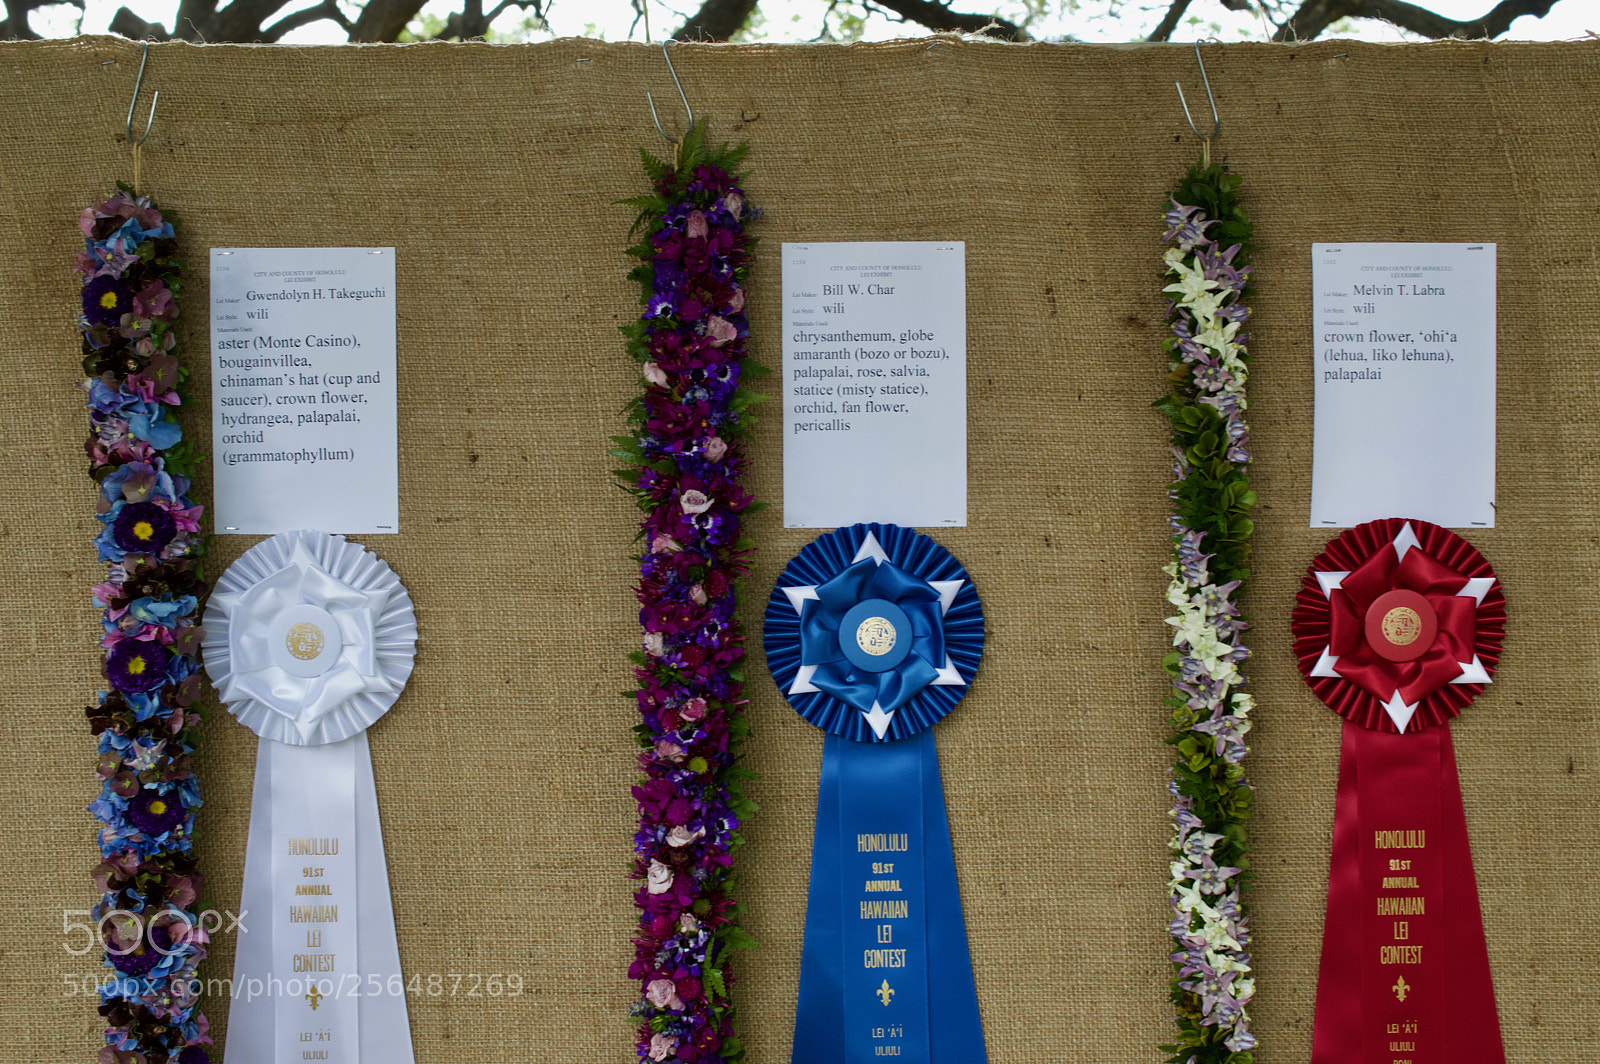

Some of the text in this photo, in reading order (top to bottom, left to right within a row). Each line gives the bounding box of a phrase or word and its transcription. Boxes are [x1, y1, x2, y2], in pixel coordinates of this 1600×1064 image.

[246, 287, 386, 302] Gwendolyn H. Takeguchi
[823, 284, 895, 296] Bill W. Char
[1353, 284, 1445, 296] Melvin T. Labra
[247, 309, 268, 319] wili
[822, 303, 844, 314] wili
[1353, 303, 1375, 313] wili
[218, 334, 360, 350] aster (Monte Casino),
[793, 330, 934, 344] chrysanthemum, globe
[1324, 333, 1364, 343] crown
[1369, 330, 1414, 343] flower,
[794, 348, 949, 361] amaranth (bozo or bozu),
[1324, 349, 1454, 363] (lehua, liko lehuna),
[219, 355, 312, 371] bougainvillea,
[299, 373, 319, 385] hat
[323, 373, 352, 387] (cup
[357, 371, 380, 383] and
[794, 365, 930, 381] palapalai, rose, salvia,
[1324, 368, 1381, 383] palapalai
[794, 383, 928, 397] statice (misty statice),
[221, 392, 368, 407] saucer), crown flower,
[794, 401, 909, 414] orchid, fan flower,
[221, 410, 360, 428] hydrangea, palapalai,
[794, 419, 850, 434] pericallis
[222, 431, 264, 444] orchid
[223, 448, 354, 465] (grammatophyllum)
[857, 834, 908, 852] HONOLULU
[1375, 830, 1425, 848] HONOLULU
[288, 837, 338, 856] HONOLULU
[872, 863, 894, 874] 91ST
[1389, 859, 1411, 870] 91ST
[302, 867, 324, 877] 91ST
[865, 880, 902, 892] ANNUAL
[1382, 877, 1419, 889] ANNUAL
[295, 885, 332, 896] ANNUAL
[860, 900, 908, 919] HAWAIIAN
[1377, 897, 1425, 915] HAWAIIAN
[290, 905, 338, 923] HAWAIIAN
[877, 925, 892, 943] LEI
[1394, 922, 1408, 939] LEI
[307, 930, 321, 947] LEI
[864, 949, 906, 968] CONTEST
[1380, 946, 1423, 964] CONTEST
[293, 954, 335, 972] CONTEST
[872, 1028, 884, 1038] LEI
[1387, 1024, 1399, 1034] LEI
[300, 1032, 312, 1041] LEI
[875, 1046, 900, 1056] ULIULI
[1390, 1042, 1415, 1052] ULIULI
[303, 1051, 328, 1060] ULIULI
